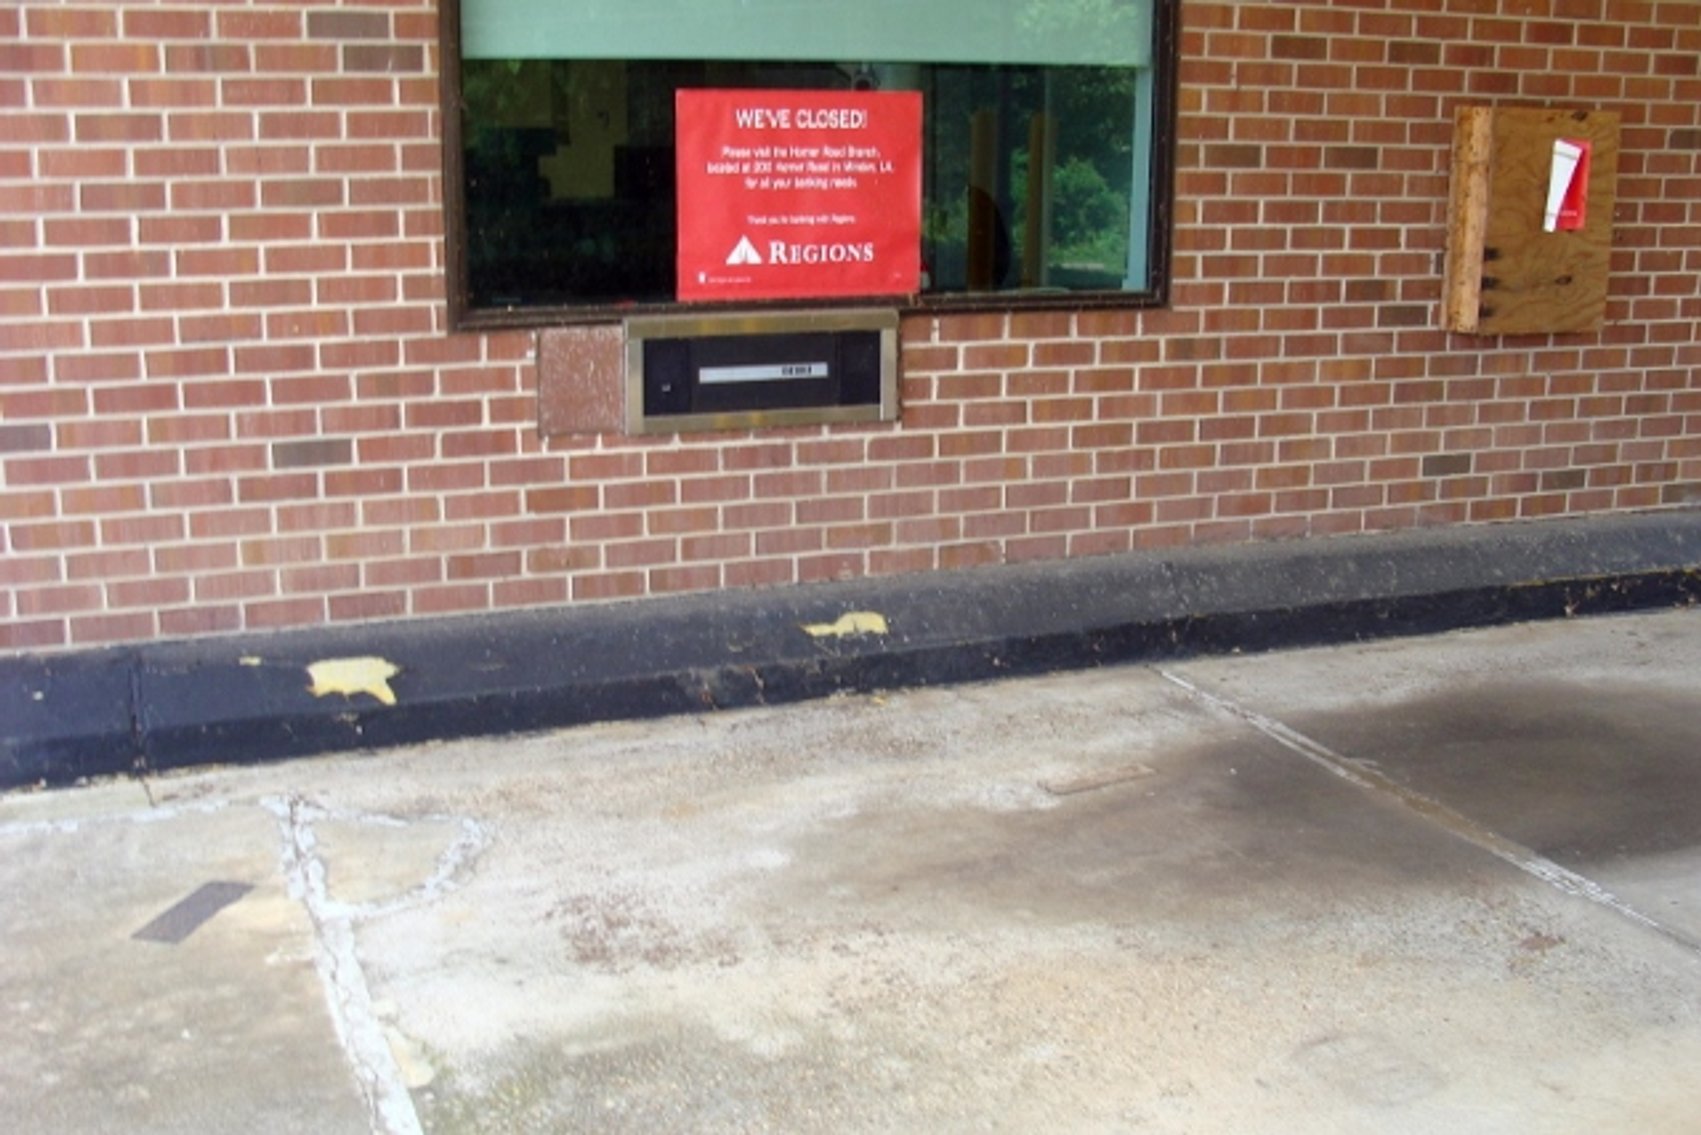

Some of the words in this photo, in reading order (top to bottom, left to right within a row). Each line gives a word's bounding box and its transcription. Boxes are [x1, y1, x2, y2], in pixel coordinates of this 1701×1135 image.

[736, 108, 790, 129] WE'VE
[796, 108, 868, 129] CLOSED!
[769, 241, 875, 264] REGIONS
